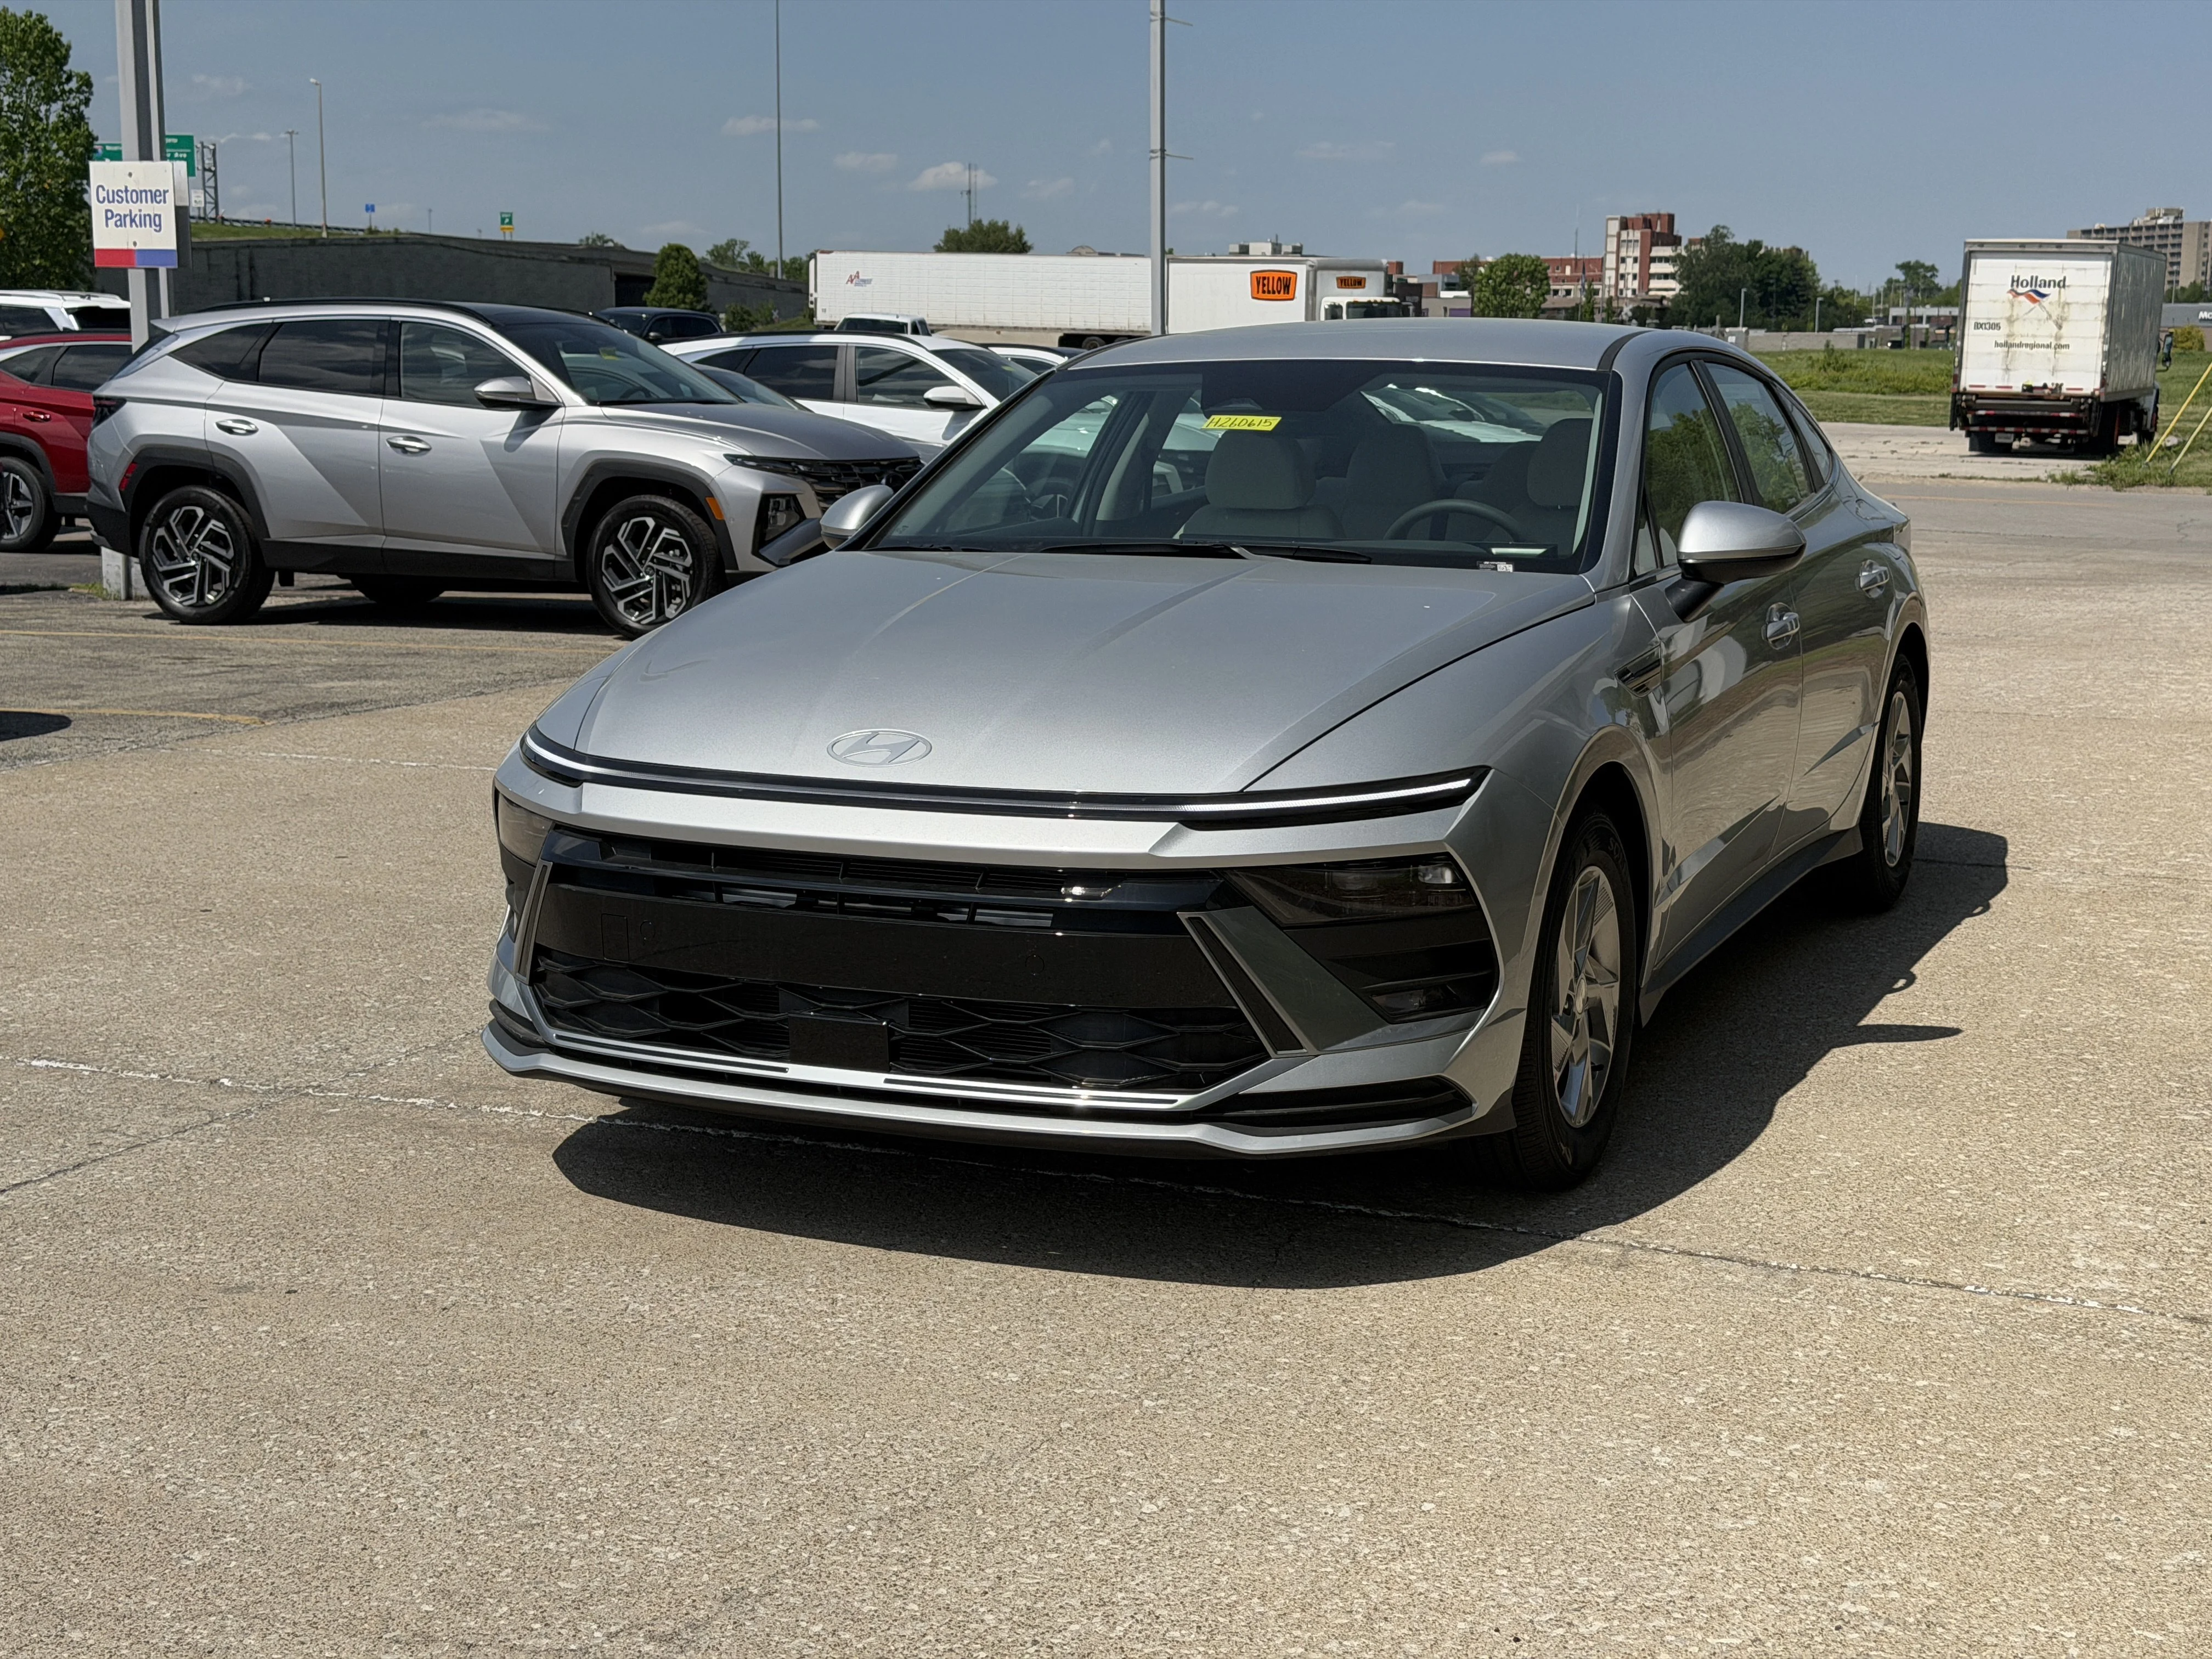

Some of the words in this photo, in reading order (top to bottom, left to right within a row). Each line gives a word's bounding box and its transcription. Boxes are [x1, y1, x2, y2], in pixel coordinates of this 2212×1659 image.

[95, 184, 169, 204] Customer
[104, 208, 162, 233] Parking
[1256, 276, 1291, 295] YELLOW
[1339, 278, 1363, 286] YELLOW
[2010, 275, 2067, 289] Holland
[1994, 340, 2070, 351] hollandregional.com
[1206, 417, 1275, 428] H260615
